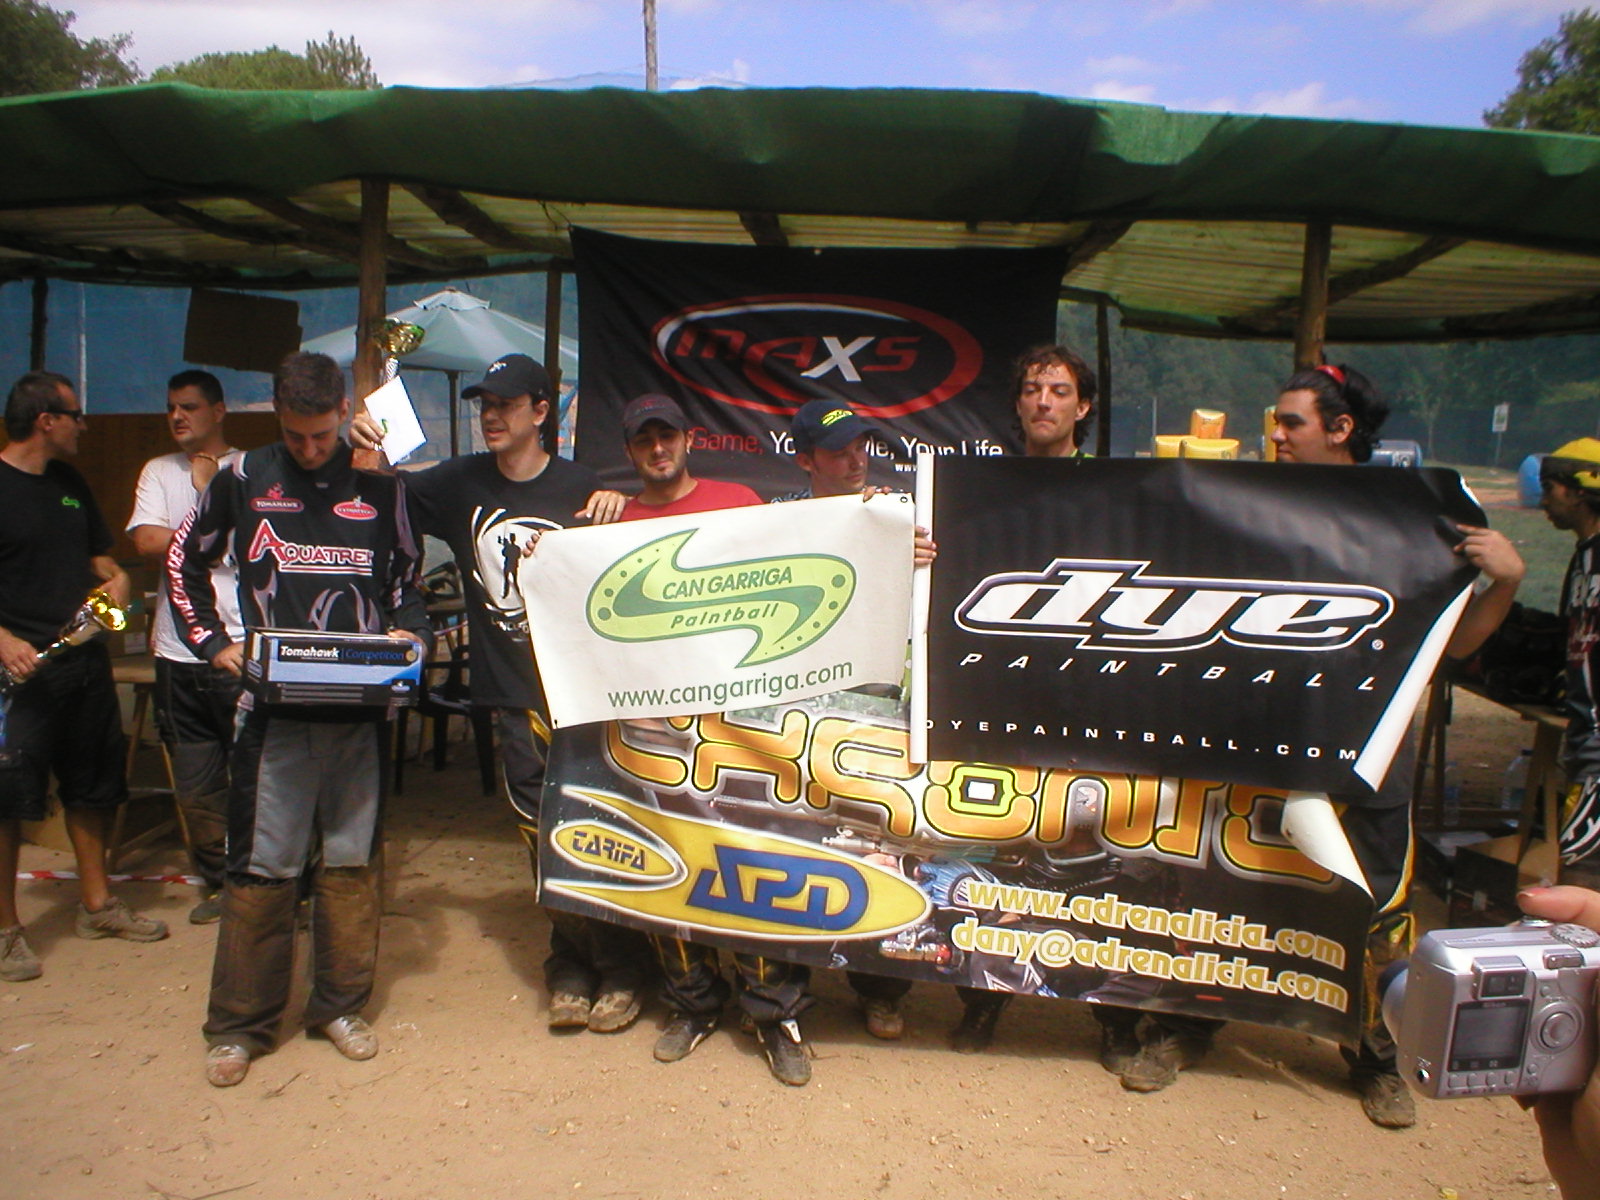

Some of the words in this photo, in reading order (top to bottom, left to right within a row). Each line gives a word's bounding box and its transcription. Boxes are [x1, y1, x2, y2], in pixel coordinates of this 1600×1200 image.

[662, 577, 705, 601] CAN
[706, 566, 793, 594] GARRIGA
[961, 564, 1389, 646] dye
[279, 645, 340, 658] Tomahawk
[959, 651, 1378, 692] PAINTBALL
[607, 661, 853, 708] www.cangarriga.com
[926, 719, 1357, 762] DYEPAINTBALL.COM
[571, 829, 646, 873] TARIFA
[966, 881, 1346, 971] www.adrenalicia.com
[951, 916, 1348, 1013] dany@adrenalicia.com
